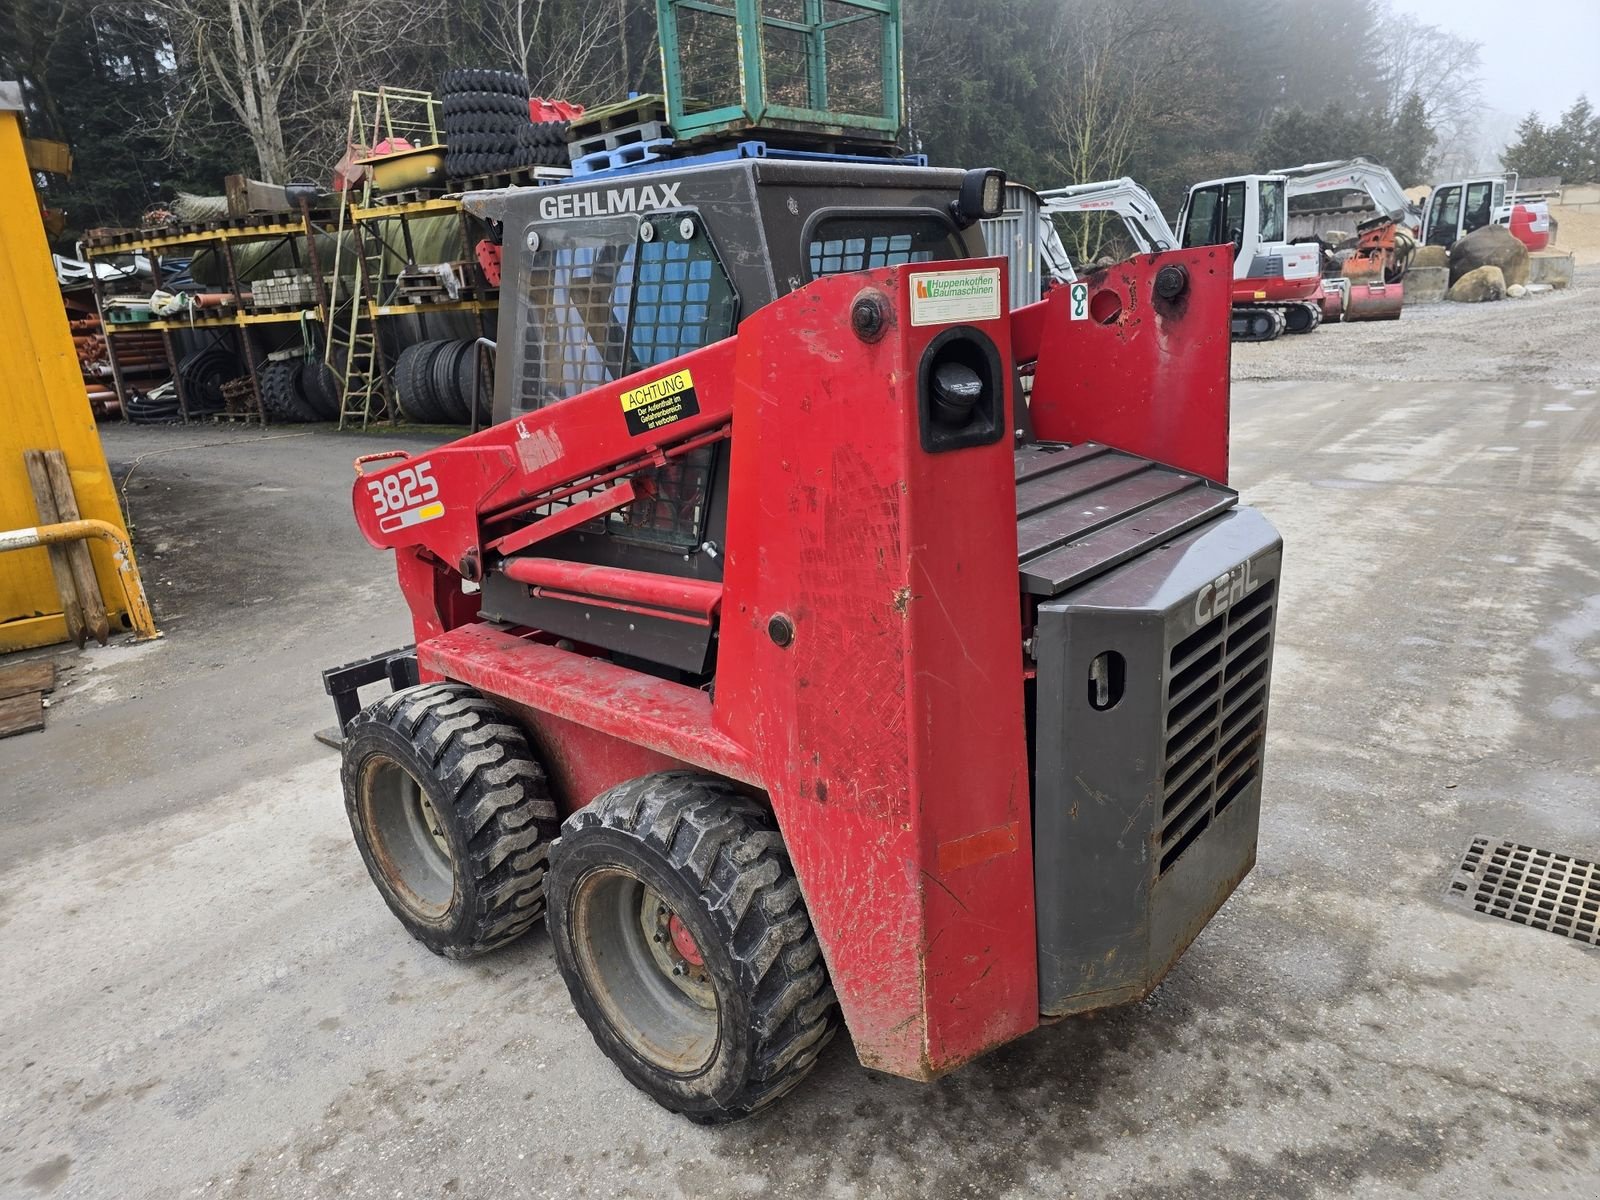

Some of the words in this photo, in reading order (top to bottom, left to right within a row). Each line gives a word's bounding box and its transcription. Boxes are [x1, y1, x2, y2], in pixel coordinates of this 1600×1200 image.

[540, 182, 683, 220] GEHLMAX
[931, 275, 993, 289] Huppenkothen
[933, 286, 993, 298] Baumaschinen
[629, 375, 684, 408] ACHTUNG
[637, 408, 648, 416] Der
[648, 397, 673, 412] Aufenthalt
[655, 414, 678, 427] verboten
[367, 460, 439, 516] 3825
